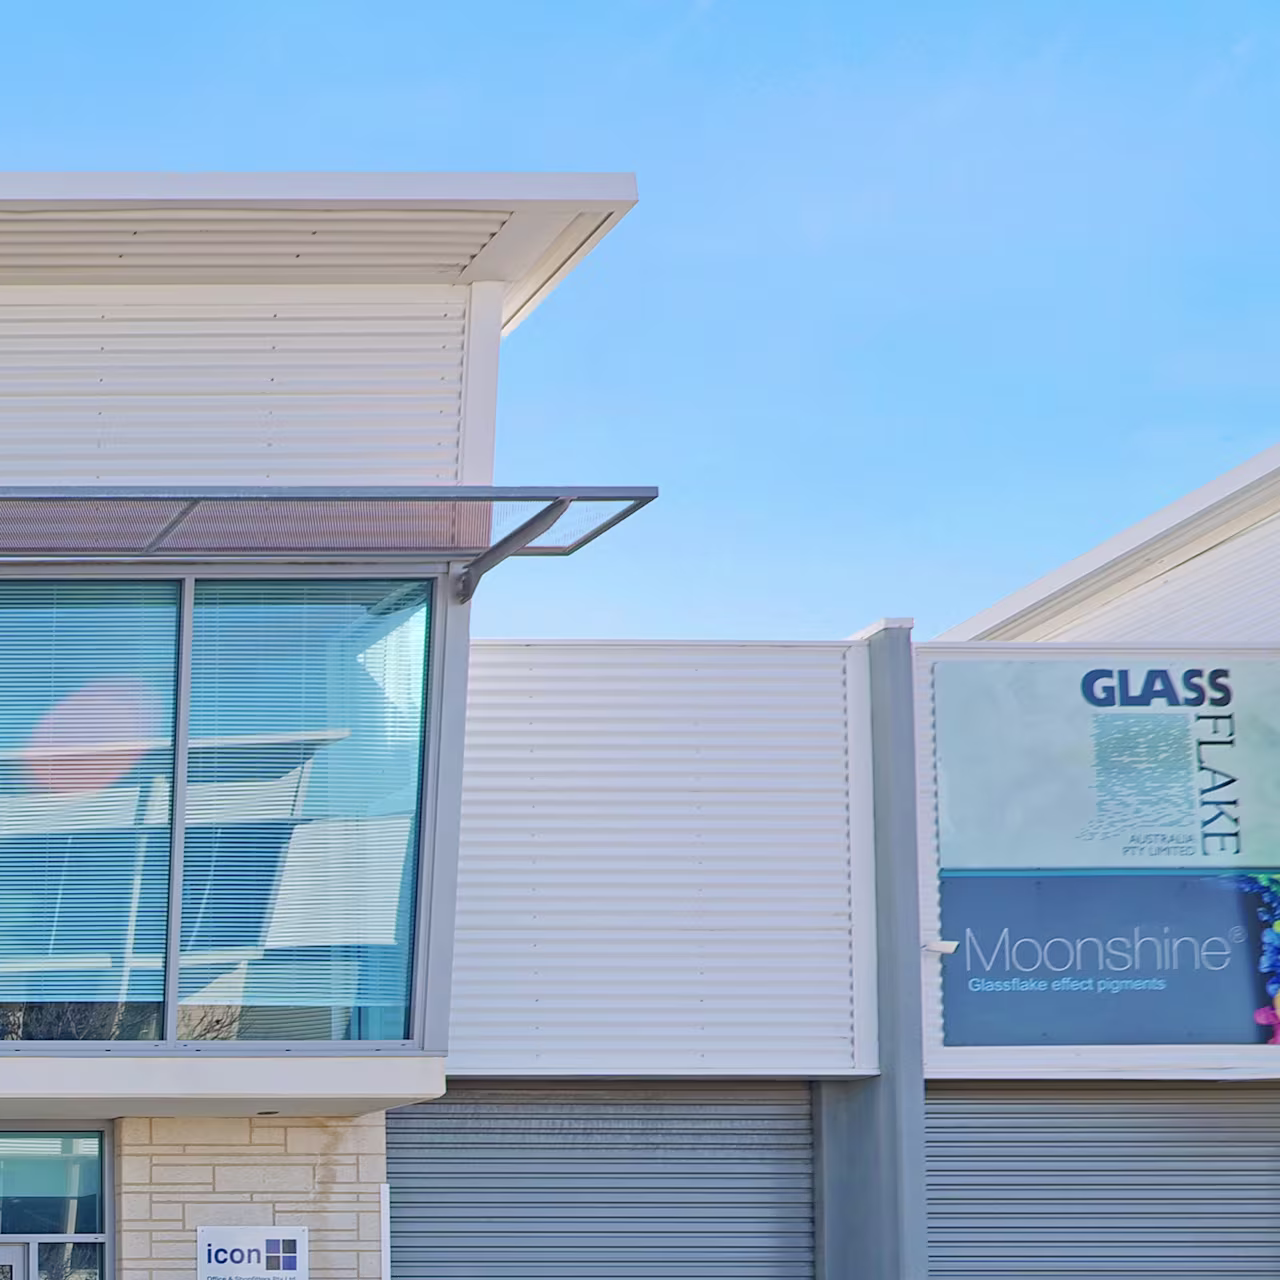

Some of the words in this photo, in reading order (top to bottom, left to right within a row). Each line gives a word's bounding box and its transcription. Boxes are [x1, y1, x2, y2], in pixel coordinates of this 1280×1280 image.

[1080, 668, 1232, 708] GLASS
[1194, 712, 1242, 856] FLAKE
[1128, 833, 1195, 845] AUSTRALIA
[1122, 845, 1145, 857] PTY
[1149, 845, 1196, 857] LIMITED
[968, 977, 1048, 992] Glassflake
[1051, 977, 1094, 992] effect
[1097, 977, 1167, 994] pigments
[206, 1243, 262, 1265] icon
